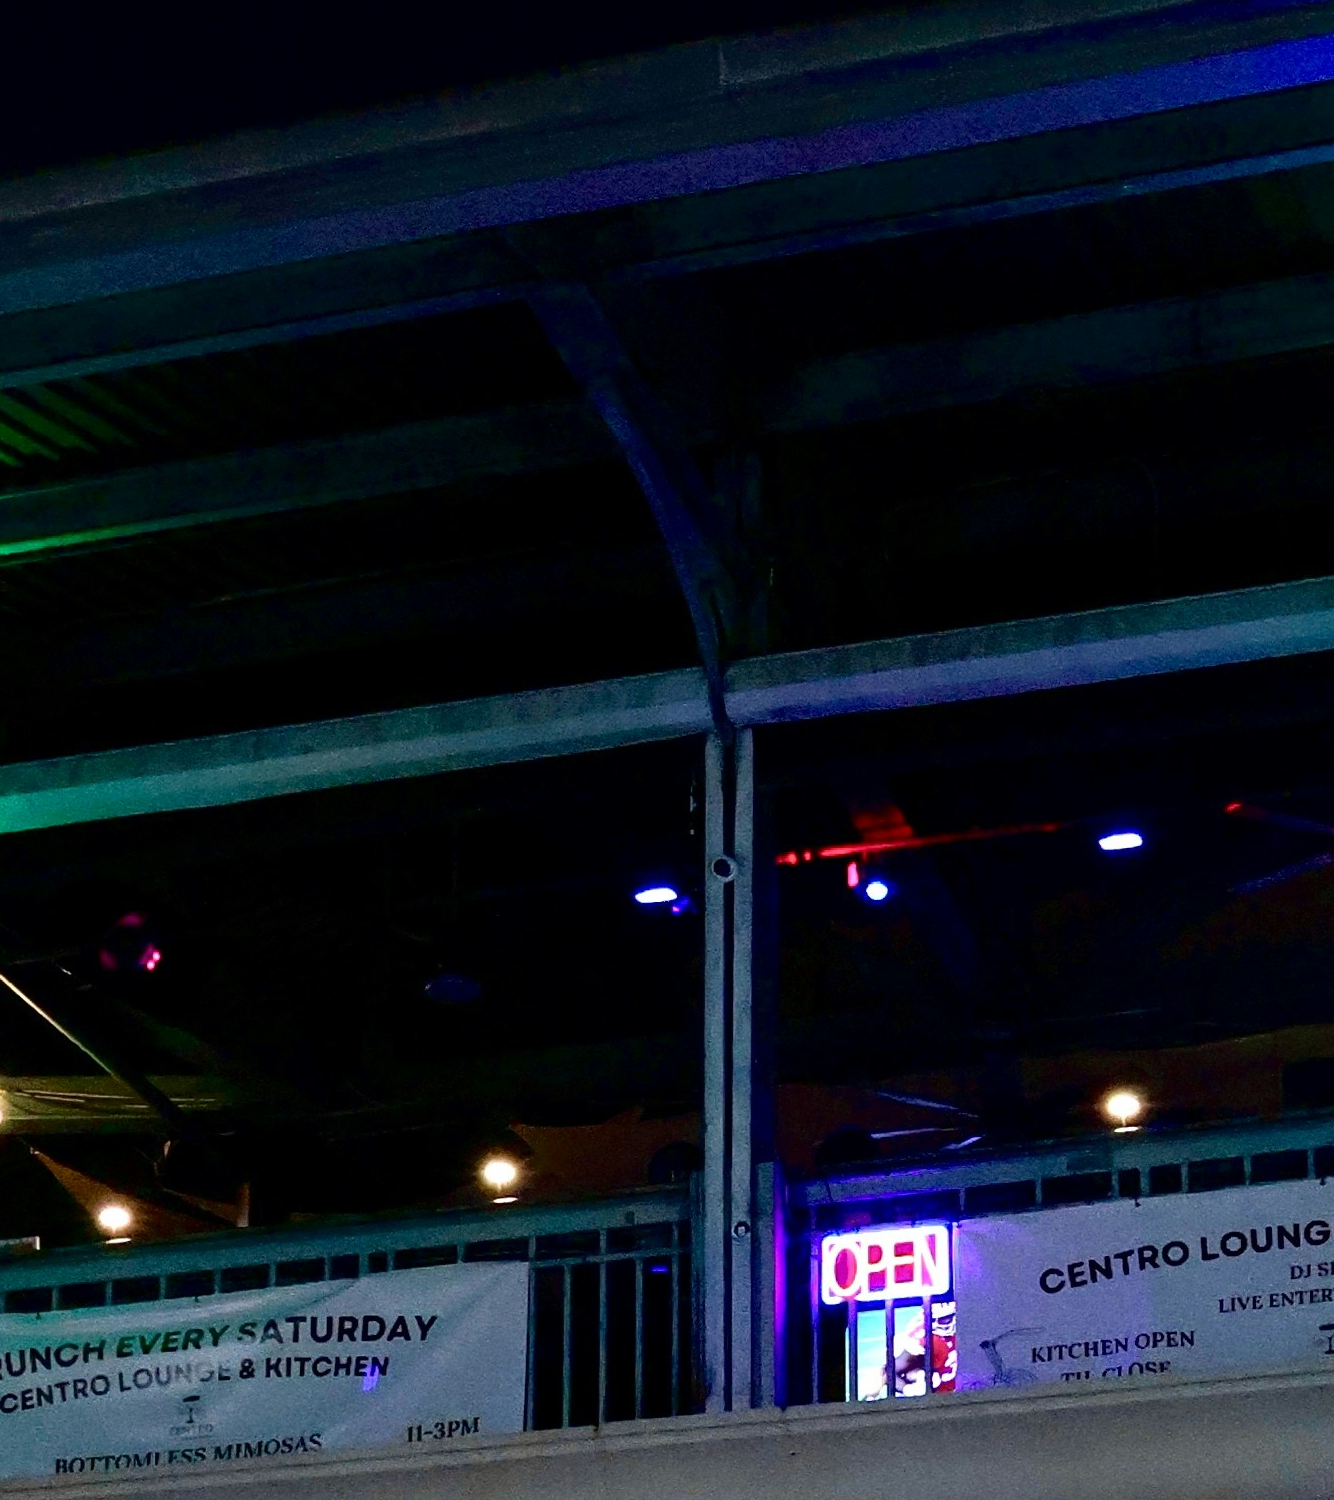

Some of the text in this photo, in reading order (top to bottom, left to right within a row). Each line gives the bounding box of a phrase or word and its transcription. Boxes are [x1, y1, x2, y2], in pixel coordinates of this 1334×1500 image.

[828, 1230, 943, 1298] OPEN
[1039, 1240, 1189, 1295] CENTRO
[1290, 1264, 1312, 1280] DJ
[1219, 1295, 1263, 1314] LIVE
[116, 1324, 229, 1358] EVERY
[237, 1315, 438, 1344] SATURDAY
[1032, 1330, 1195, 1363] KITCHEN OPEN
[119, 1362, 232, 1392] LOUNGE
[238, 1358, 256, 1378] &
[264, 1356, 390, 1378] KITCHEN
[407, 1416, 481, 1443] 11-3PM
[55, 1433, 323, 1475] BOTTOMLESS MIMOSAS
